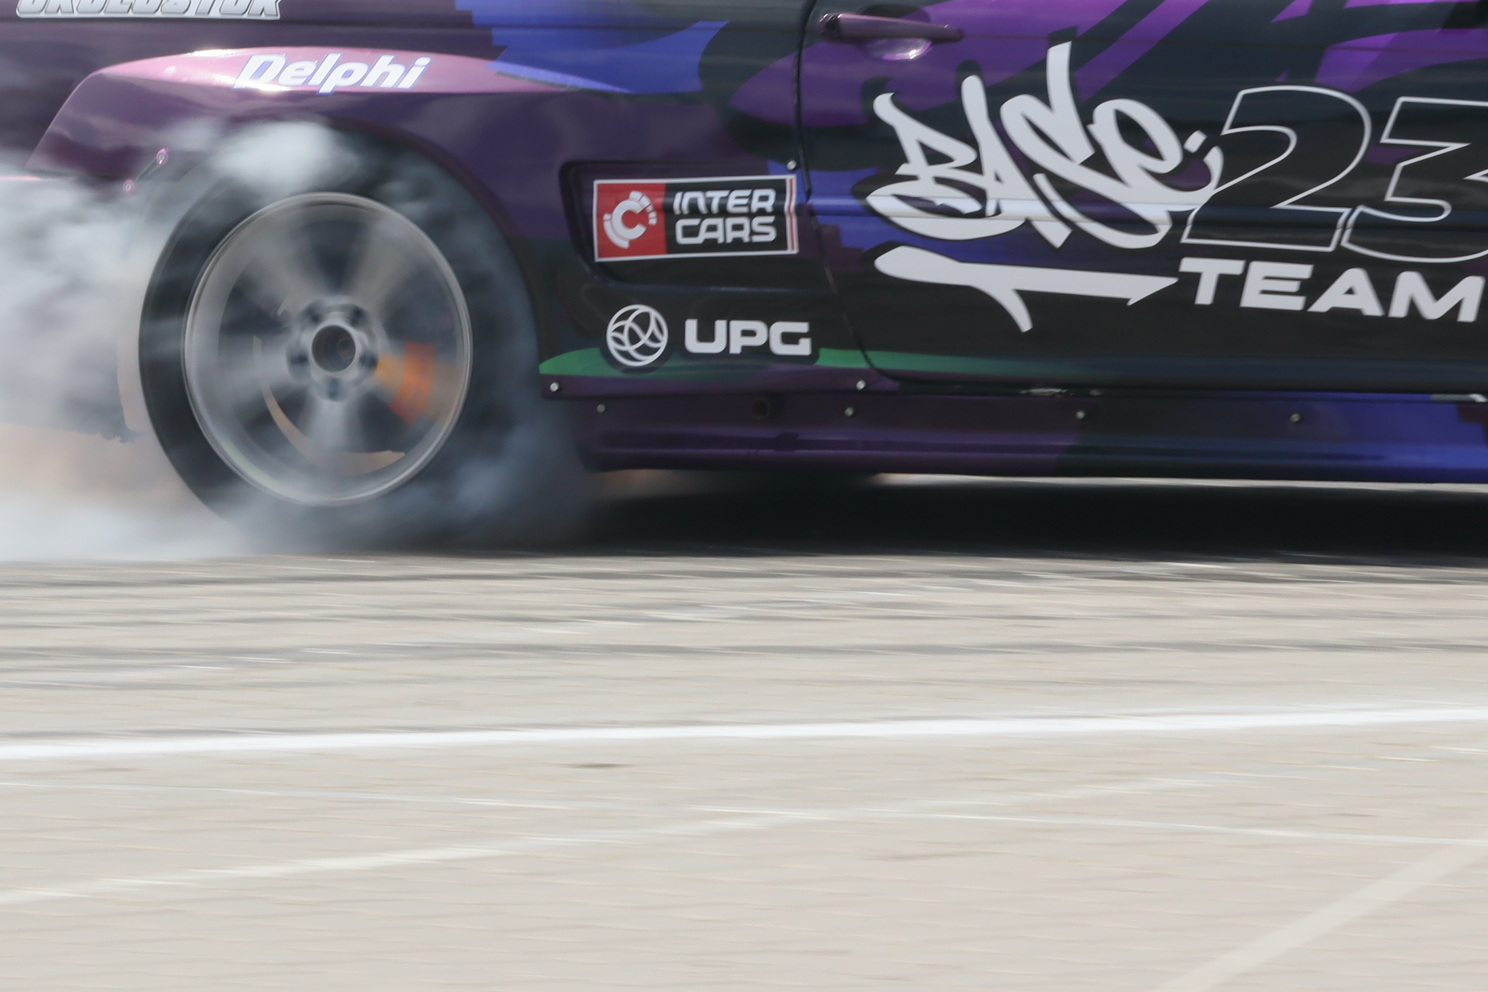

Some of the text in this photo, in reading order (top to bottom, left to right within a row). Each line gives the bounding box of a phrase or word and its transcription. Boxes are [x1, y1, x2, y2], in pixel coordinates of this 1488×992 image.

[232, 53, 434, 95] Delphi
[672, 188, 777, 214] INTER
[674, 215, 777, 244] CARS
[1178, 257, 1486, 323] TEAM
[683, 318, 813, 356] UPG
